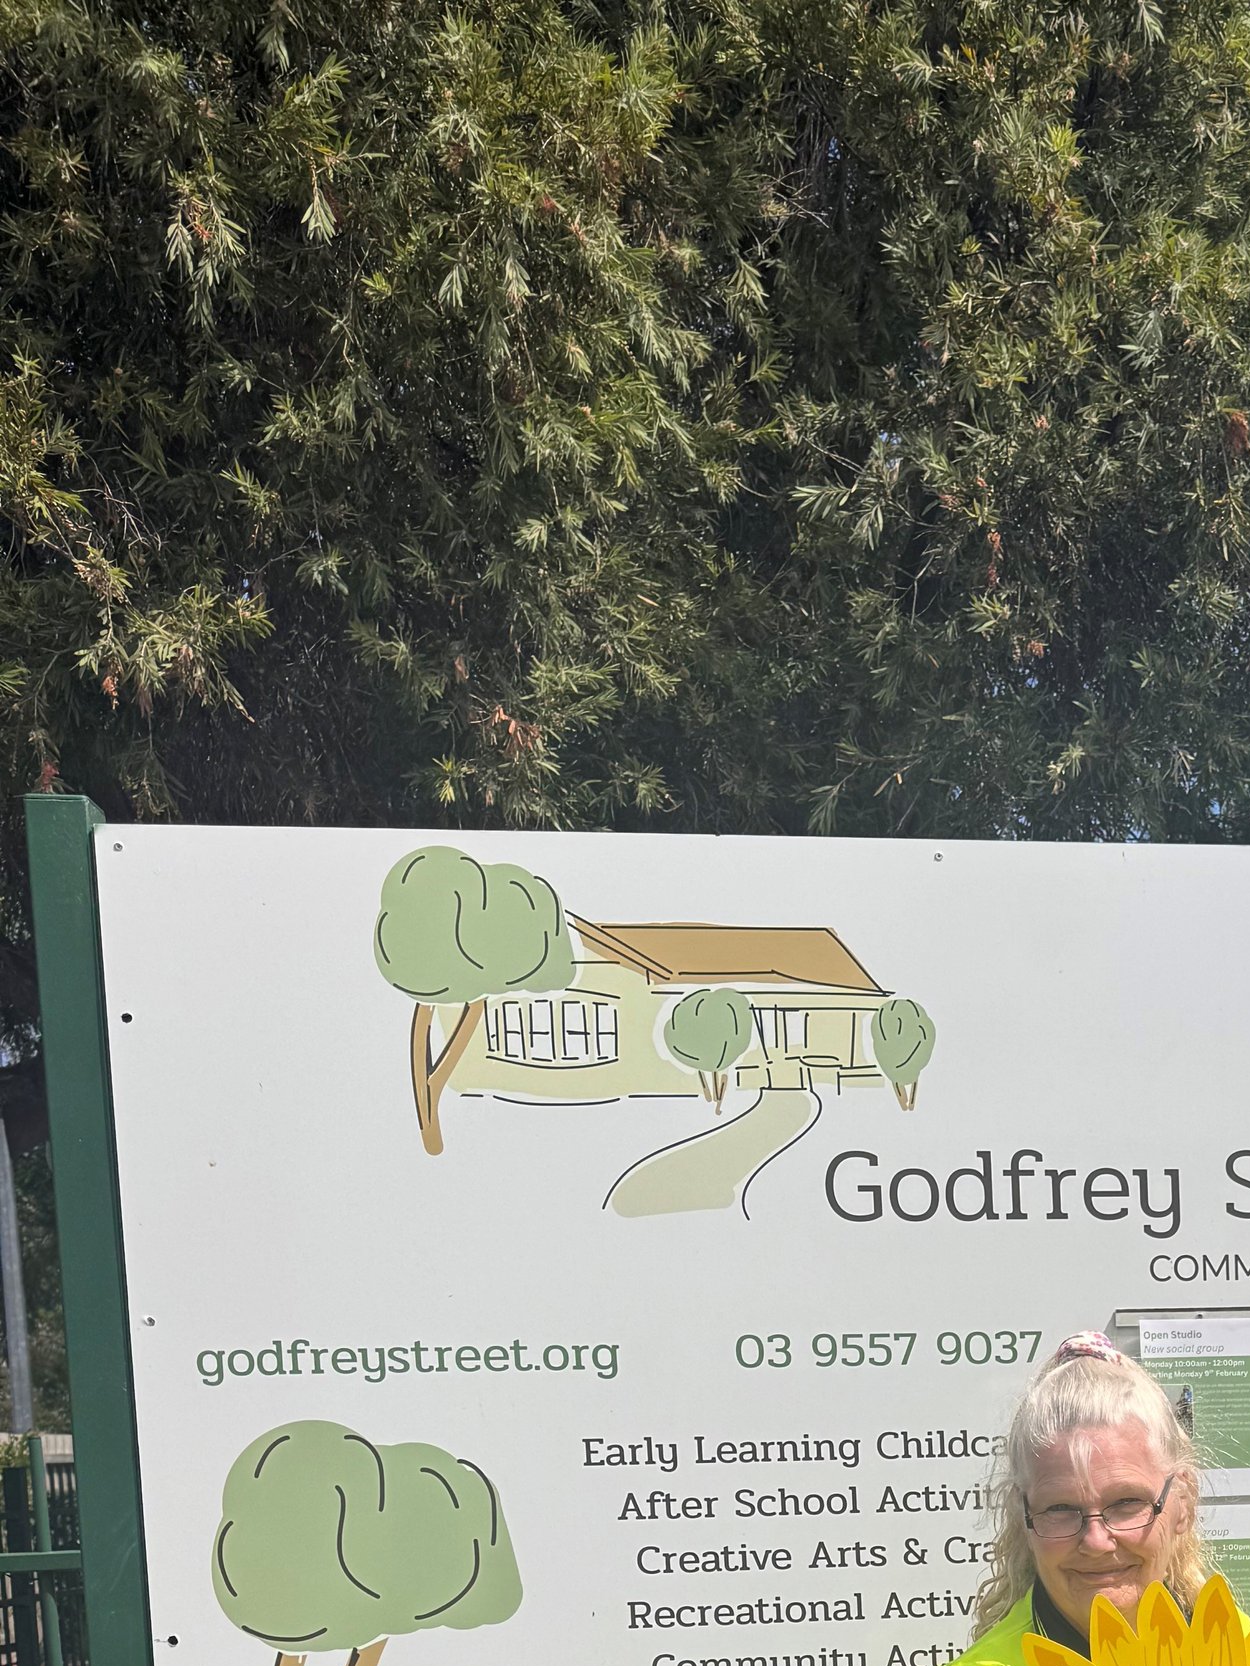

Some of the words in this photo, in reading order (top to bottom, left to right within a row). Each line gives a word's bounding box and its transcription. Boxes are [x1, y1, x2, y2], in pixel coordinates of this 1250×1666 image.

[825, 1149, 1180, 1239] Godfrey
[736, 1334, 791, 1369] 03
[812, 1333, 918, 1368] 9557
[937, 1331, 1042, 1366] 9037
[1143, 1331, 1168, 1341] Open
[1171, 1330, 1202, 1339] Studio
[1143, 1345, 1164, 1354] New
[1167, 1344, 1194, 1353] social
[1196, 1345, 1224, 1354] group
[196, 1338, 620, 1387] godfreystreet.org
[1144, 1361, 1173, 1369] Monday
[1174, 1360, 1207, 1368] 10:00am
[1212, 1359, 1245, 1368] 12:00pm
[1147, 1371, 1173, 1379] tarting
[1173, 1371, 1203, 1379] Monday
[1215, 1370, 1248, 1378] February
[582, 1436, 678, 1473] Early
[694, 1436, 861, 1468] Learning
[876, 1430, 1008, 1460] Childca
[618, 1491, 719, 1521] After
[735, 1486, 861, 1518] School
[876, 1484, 997, 1513] Activit
[637, 1543, 791, 1575] Creative
[809, 1541, 887, 1569] Arts
[903, 1537, 928, 1566] &
[944, 1536, 998, 1564] Cra
[627, 1592, 866, 1629] Recreational
[880, 1590, 976, 1620] Activ
